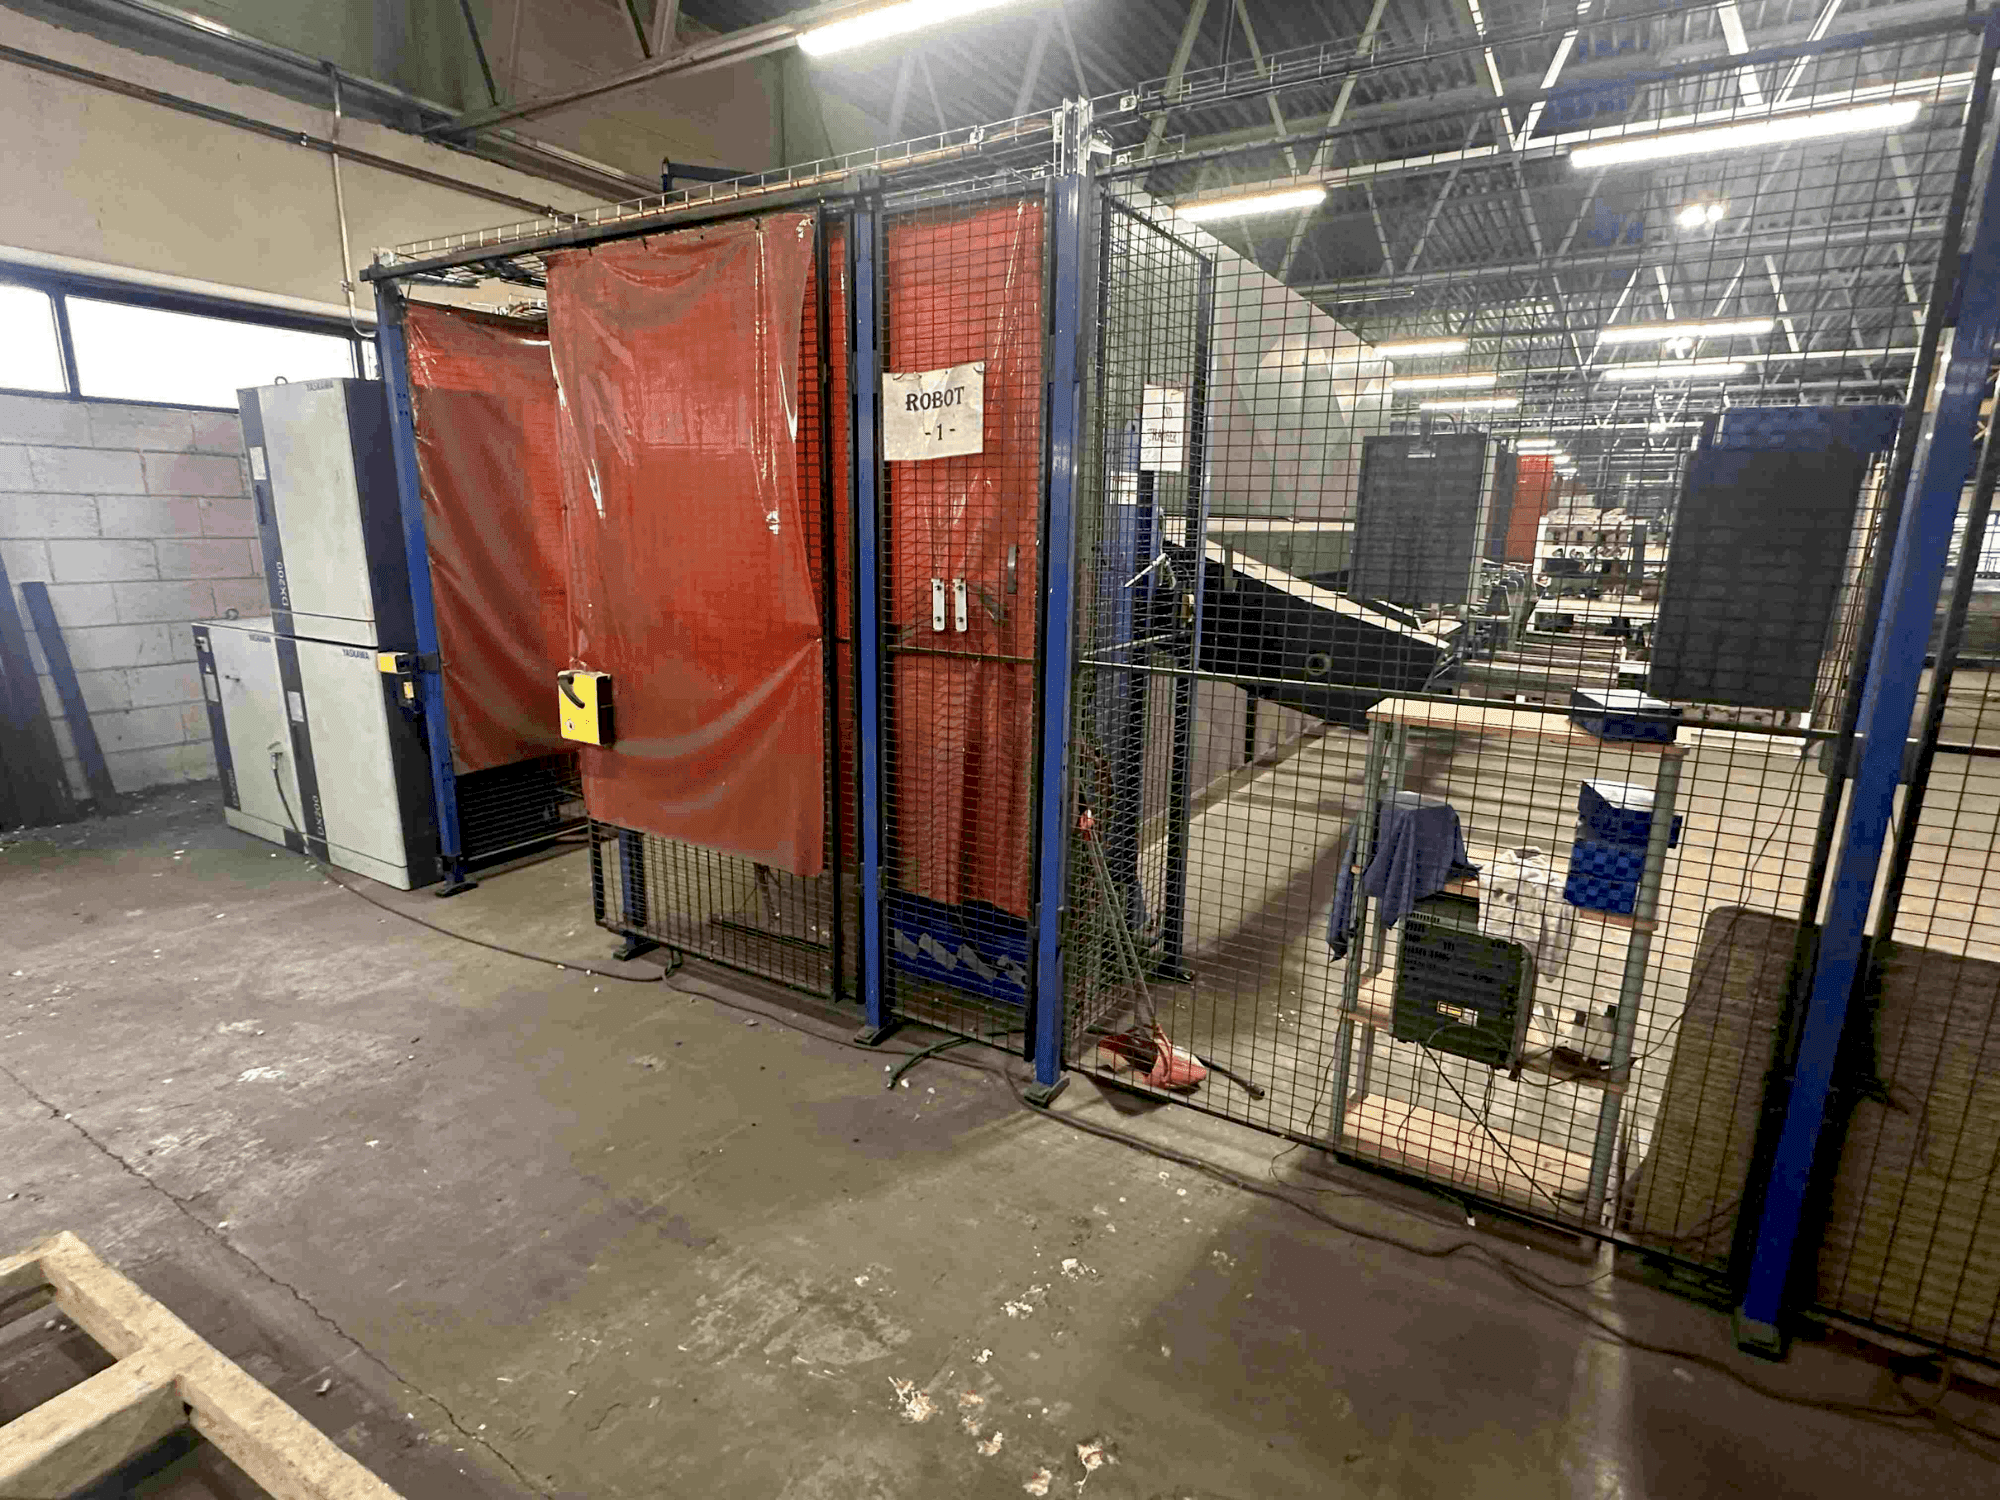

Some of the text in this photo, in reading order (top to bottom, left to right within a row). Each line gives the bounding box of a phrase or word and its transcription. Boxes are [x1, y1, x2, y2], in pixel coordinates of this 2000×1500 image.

[905, 386, 965, 412] ROBOT
[276, 561, 290, 606] DX200
[312, 795, 325, 836] DX200
